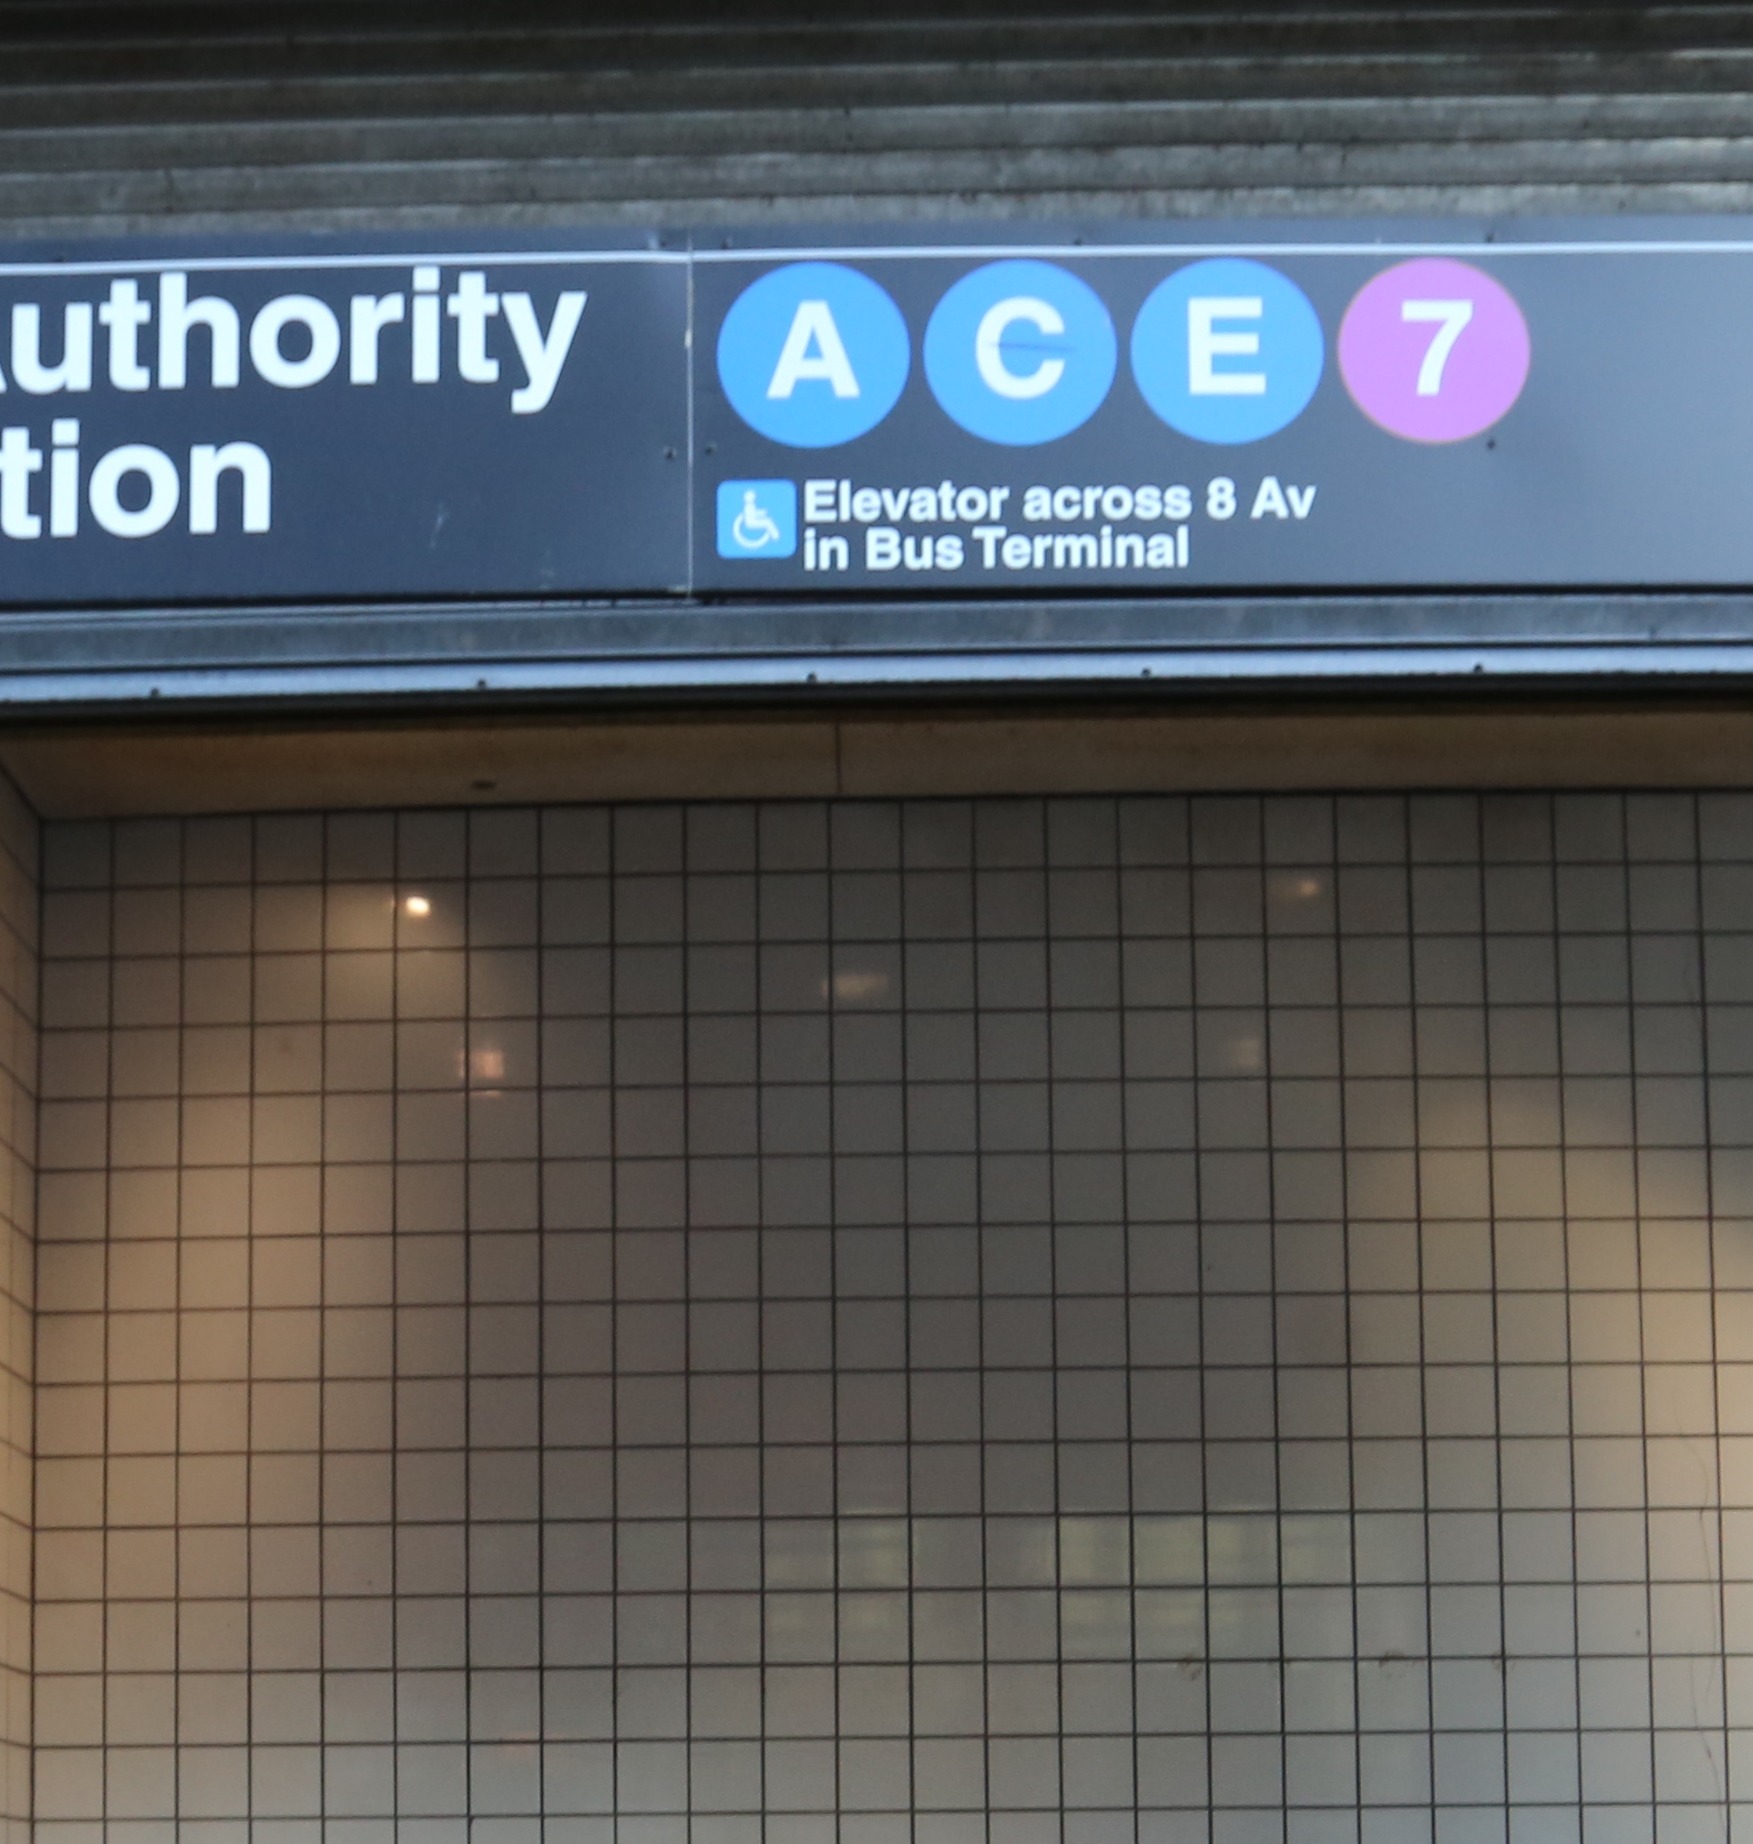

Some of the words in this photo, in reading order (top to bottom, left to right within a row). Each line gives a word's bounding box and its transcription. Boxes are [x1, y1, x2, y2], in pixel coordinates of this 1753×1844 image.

[765, 300, 861, 400] A
[974, 296, 1067, 399] C
[1187, 296, 1267, 397] E
[1400, 298, 1474, 397] 7
[803, 479, 1009, 523] Elevator
[1023, 482, 1191, 522] across
[1205, 477, 1237, 521] 8
[1250, 476, 1317, 521] Av
[804, 527, 849, 571] in
[865, 527, 964, 571] Bus
[973, 524, 1190, 571] Terminal
